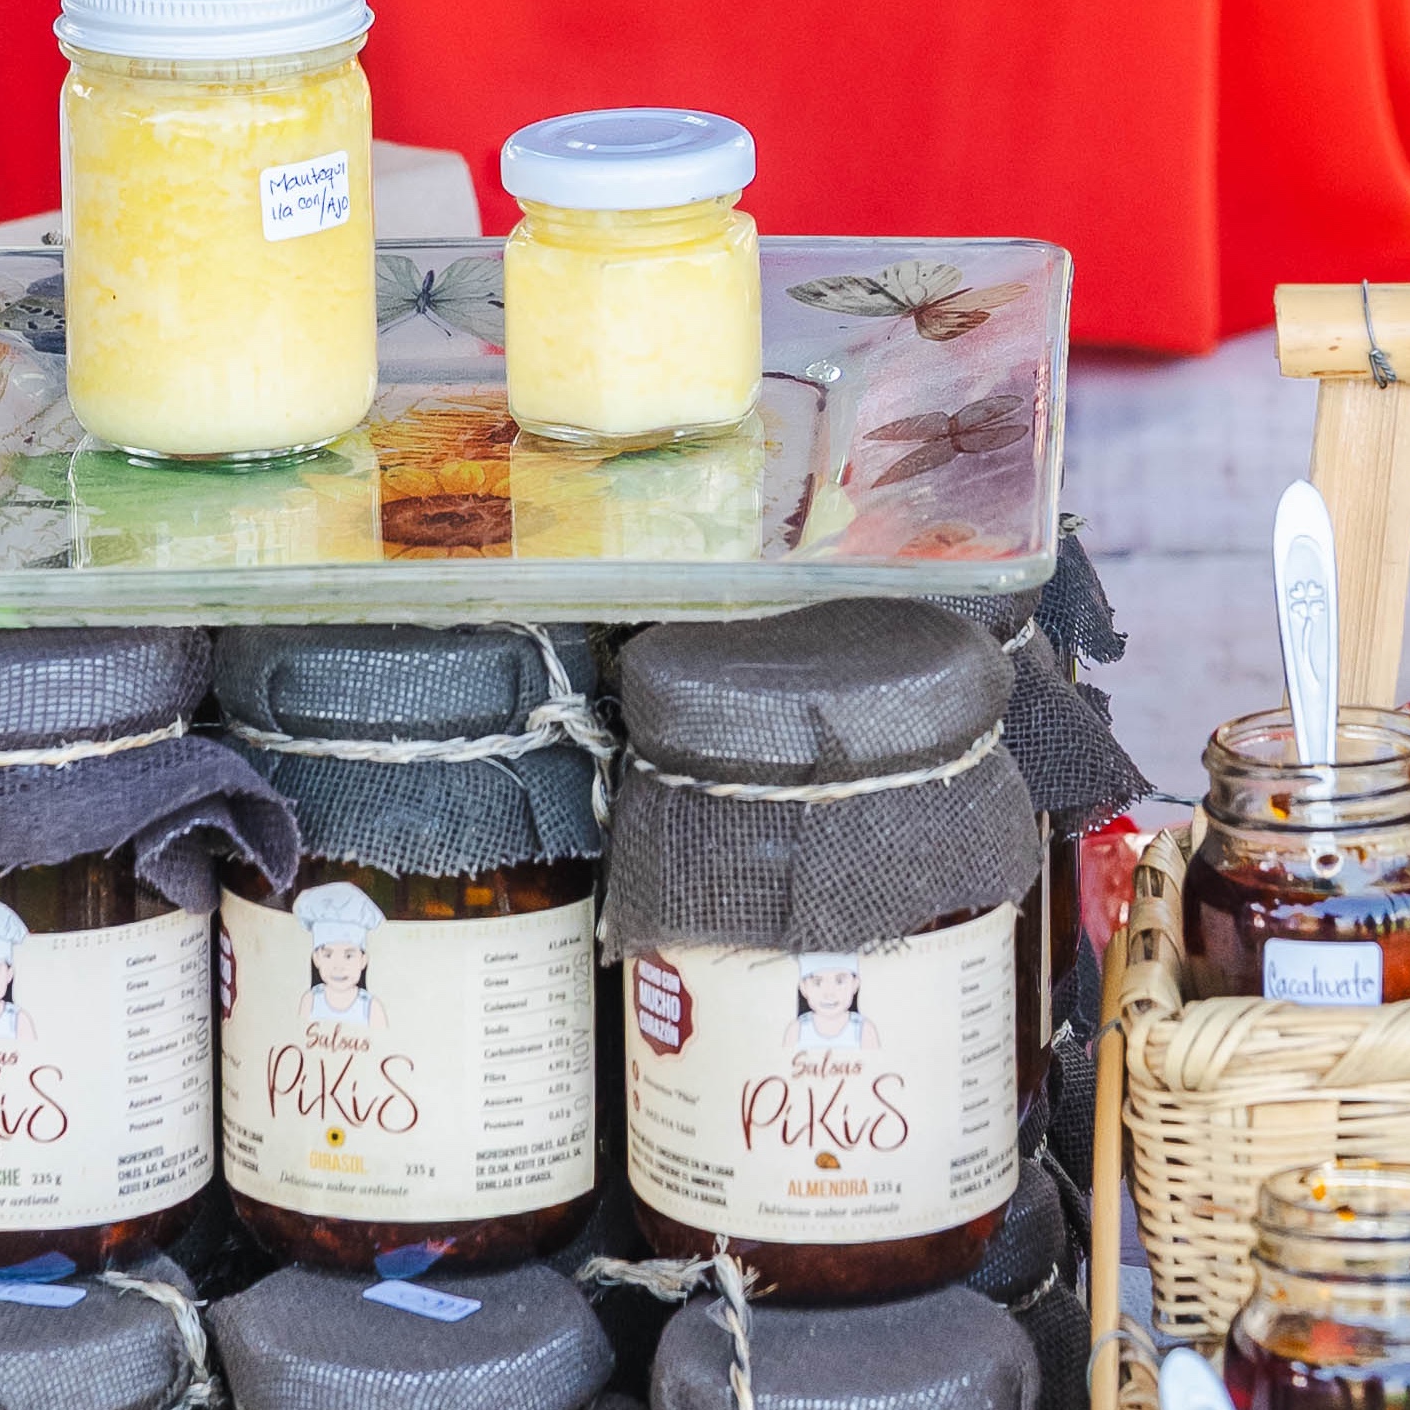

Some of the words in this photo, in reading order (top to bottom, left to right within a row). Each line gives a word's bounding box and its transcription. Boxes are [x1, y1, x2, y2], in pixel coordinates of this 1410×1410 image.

[638, 979, 681, 1023] MUCHO
[306, 1021, 370, 1053] Salsas
[791, 1049, 863, 1080] Salsas
[310, 1150, 367, 1175] GIRASOL
[787, 1178, 869, 1197] ALMENDRA
